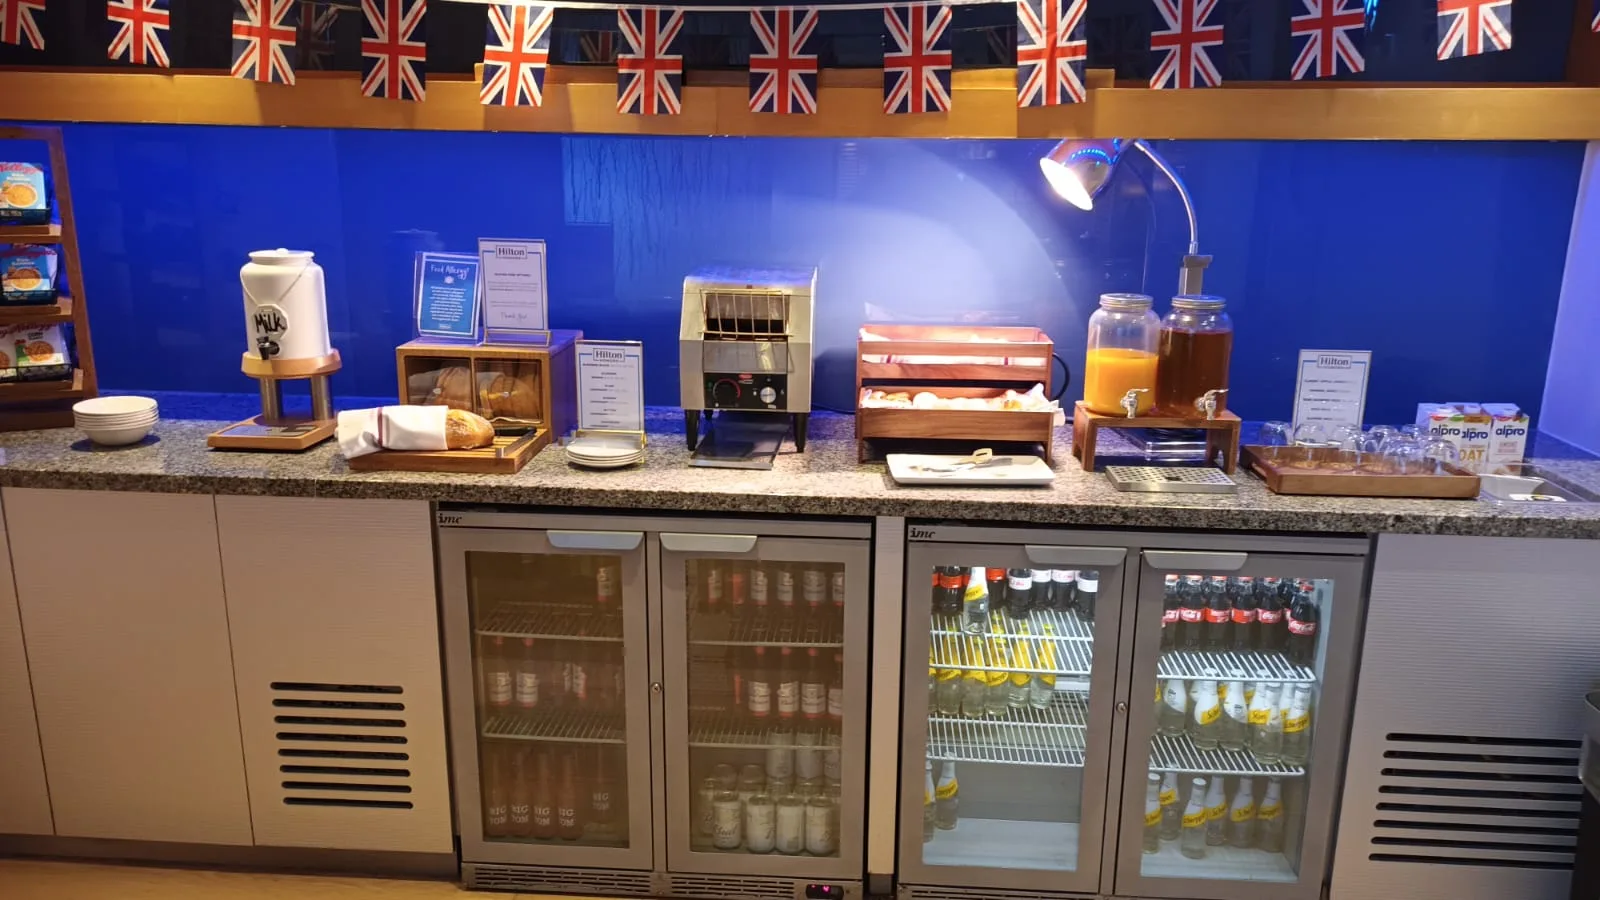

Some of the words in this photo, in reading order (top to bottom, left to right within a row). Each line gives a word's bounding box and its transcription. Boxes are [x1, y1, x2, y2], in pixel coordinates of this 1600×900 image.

[498, 247, 525, 256] Hilton
[595, 350, 622, 359] Hilton
[1320, 356, 1349, 366] Hilton
[1430, 424, 1460, 437] alpro
[1495, 424, 1525, 438] alpro
[438, 513, 463, 524] imc
[910, 527, 936, 539] imc
